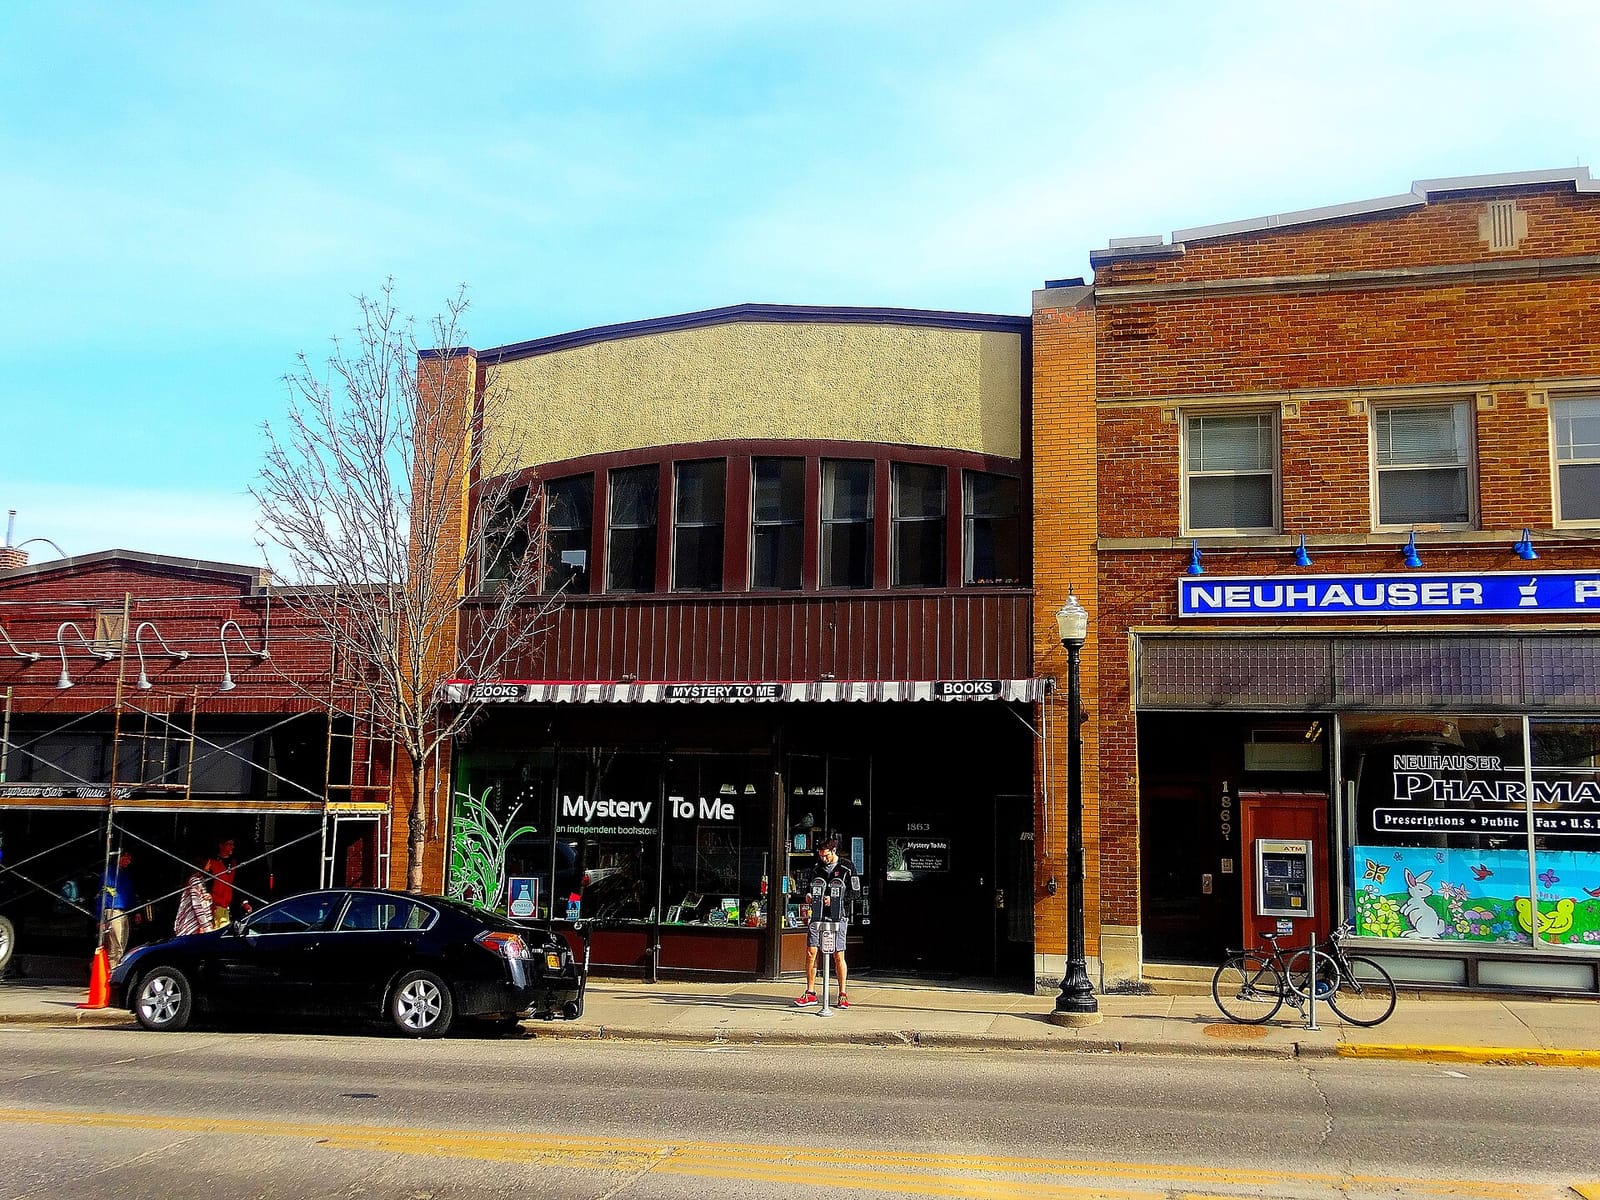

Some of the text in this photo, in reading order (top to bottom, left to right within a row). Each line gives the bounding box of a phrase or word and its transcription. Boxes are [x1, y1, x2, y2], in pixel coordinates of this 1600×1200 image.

[1190, 583, 1483, 608] NEUHAUSER
[475, 686, 519, 697] BOOKS
[672, 685, 775, 698] MYSTERY TO ME
[943, 682, 993, 695] BOOKS
[1393, 754, 1502, 771] NEUHAUSER
[562, 795, 735, 823] Mystery To Me
[907, 823, 930, 831] 1863
[1384, 814, 1595, 829] Prescriptions Public Fax U.S.
[567, 824, 617, 835] independent
[618, 825, 658, 835] bookstore
